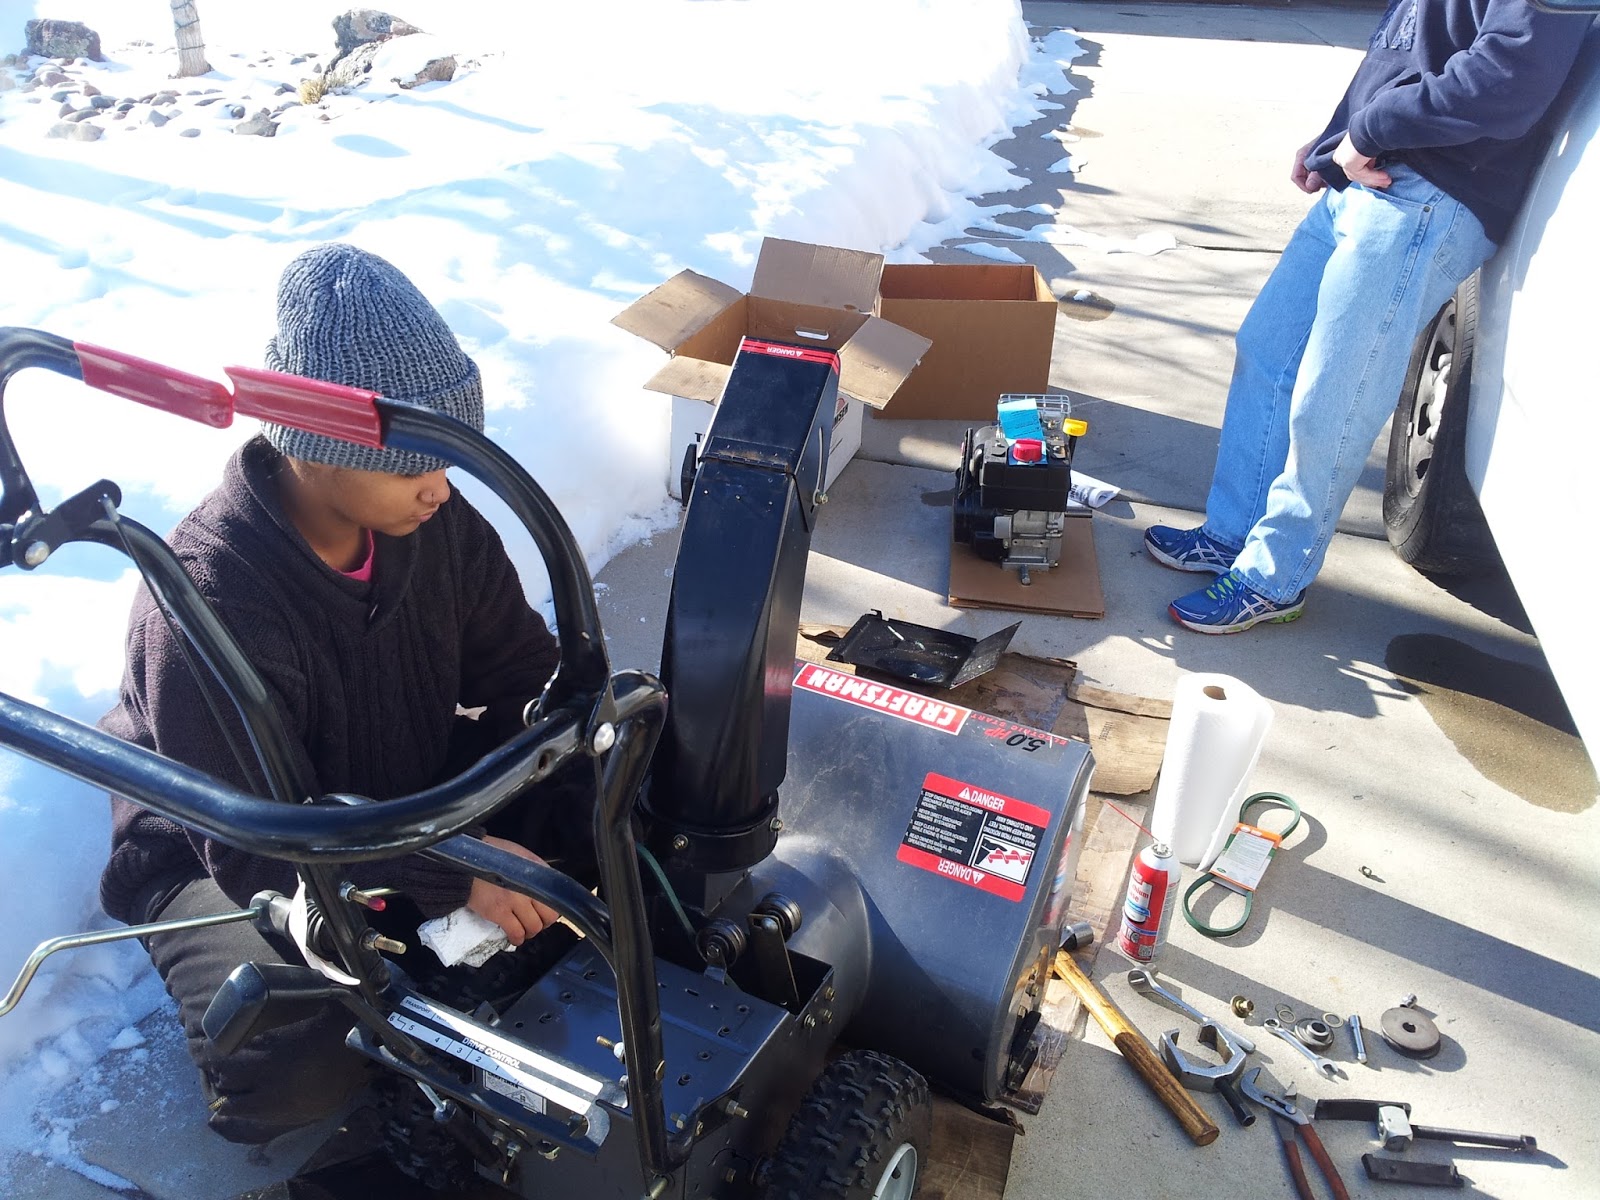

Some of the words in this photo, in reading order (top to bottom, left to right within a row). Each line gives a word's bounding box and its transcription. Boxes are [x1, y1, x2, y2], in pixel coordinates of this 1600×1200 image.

[767, 347, 794, 356] DANGER
[806, 669, 958, 726] CRAFTSMAN
[970, 711, 1006, 727] START
[1009, 723, 1067, 746] ELECTRIC
[922, 796, 942, 806] DISCHARGE
[933, 794, 946, 802] ENGINE
[946, 799, 960, 807] BEFORE
[970, 790, 1005, 811] DANGER
[941, 816, 962, 826] DISCHARGE
[937, 859, 972, 881] DANGER
[404, 999, 431, 1014] TRANSPORT
[389, 1014, 395, 1022] 6
[434, 1036, 440, 1044] 4
[456, 1046, 463, 1054] 3
[462, 1036, 485, 1052] DRIVE
[484, 1047, 521, 1069] CONTROL
